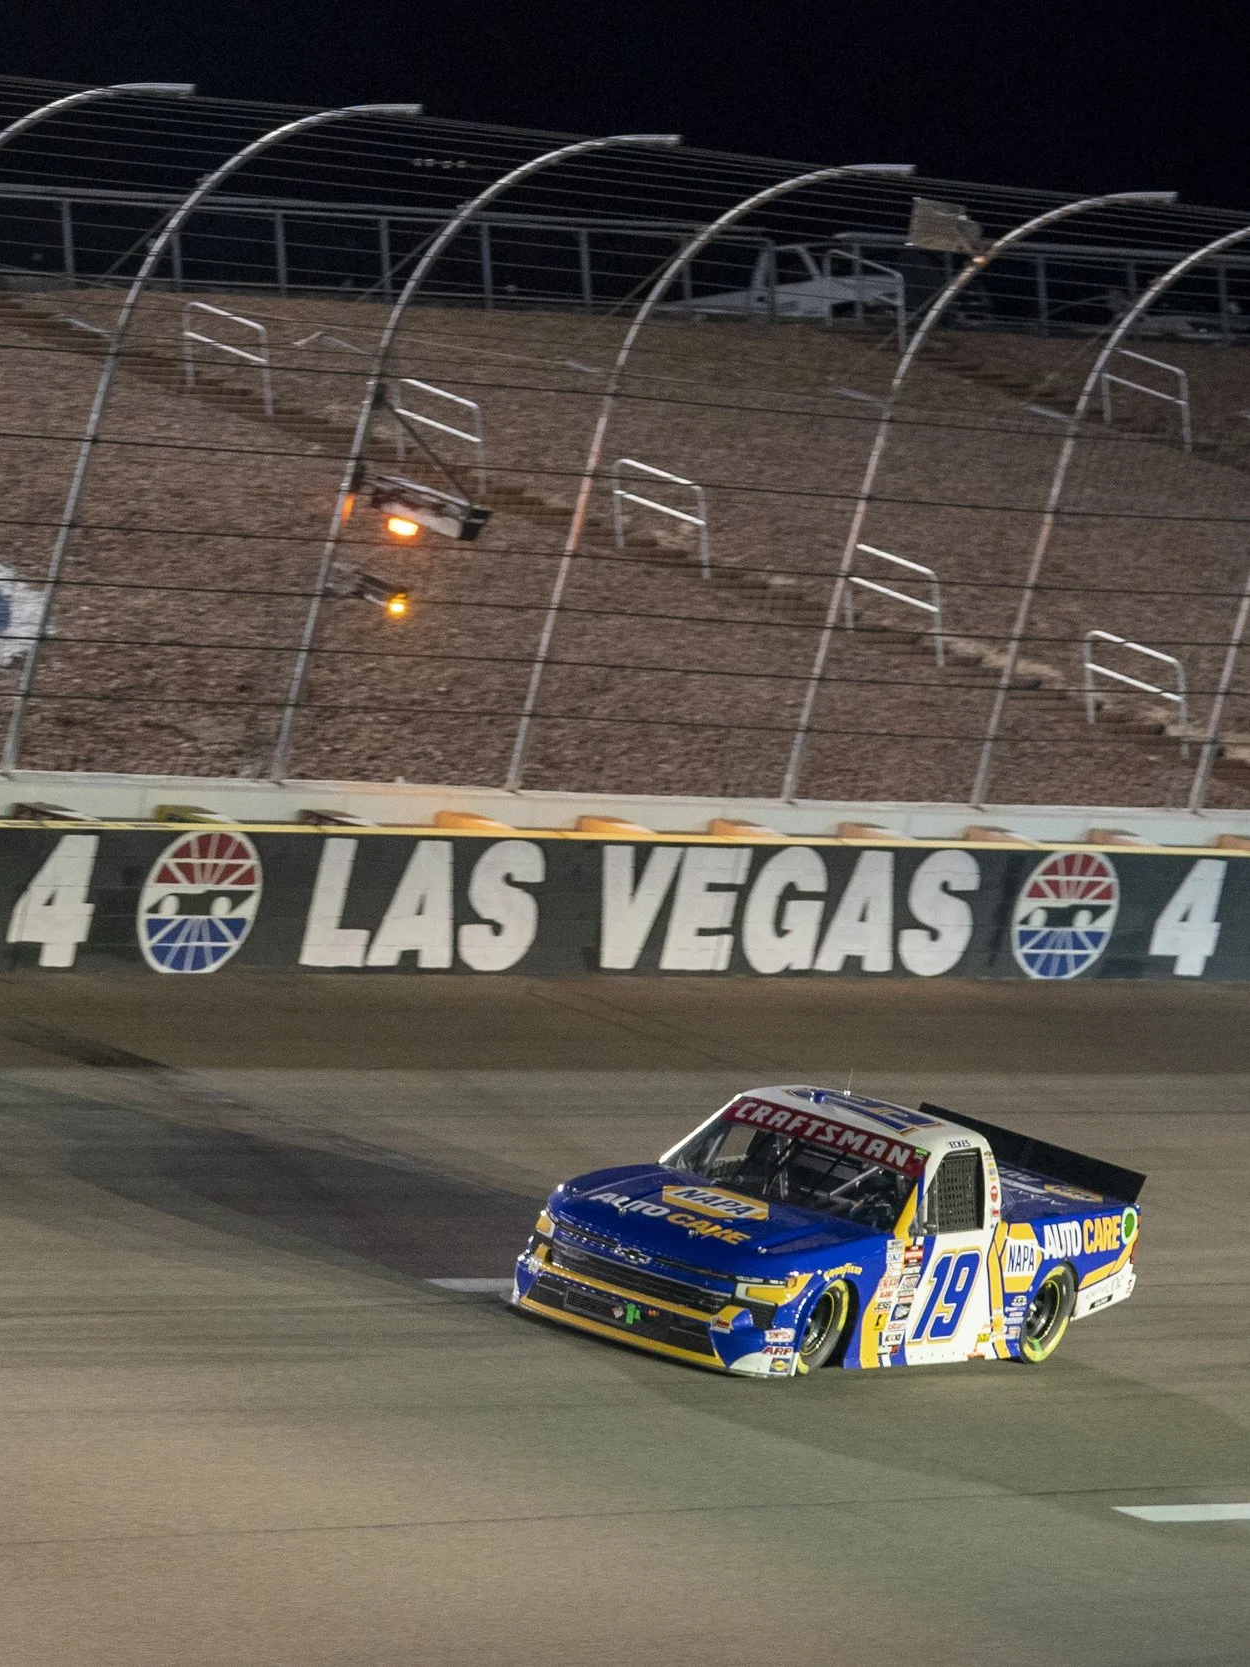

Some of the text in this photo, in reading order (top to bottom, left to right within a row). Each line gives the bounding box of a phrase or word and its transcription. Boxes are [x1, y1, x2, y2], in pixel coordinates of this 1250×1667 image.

[6, 834, 100, 968] 4
[298, 837, 981, 977] LAS VEGAS
[1149, 858, 1228, 976] 4
[735, 1102, 911, 1169] CRAFTSMAN
[588, 1192, 752, 1246] AUTO CARE
[674, 1188, 755, 1217] NAPA
[1007, 1242, 1035, 1273] NAPA
[1043, 1215, 1122, 1260] AUTO CARE
[907, 1246, 983, 1345] 19
[761, 1347, 793, 1355] ARP
